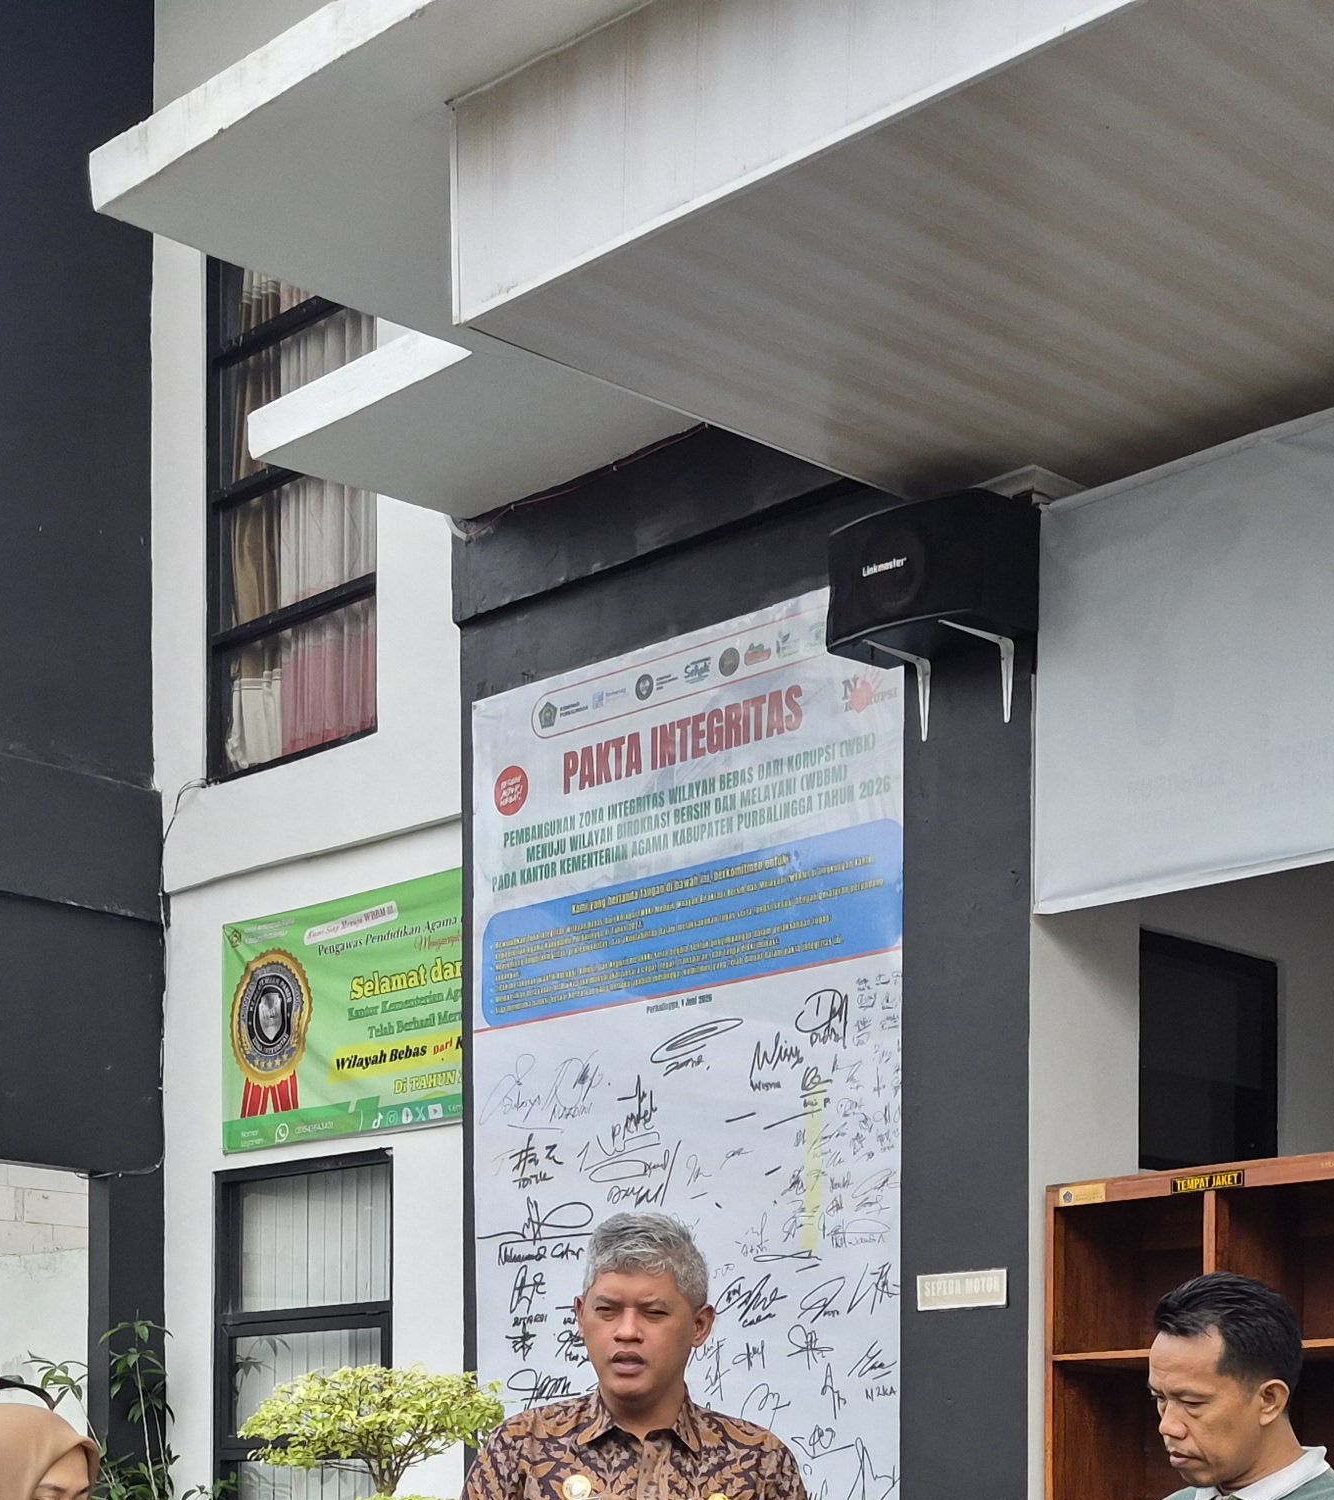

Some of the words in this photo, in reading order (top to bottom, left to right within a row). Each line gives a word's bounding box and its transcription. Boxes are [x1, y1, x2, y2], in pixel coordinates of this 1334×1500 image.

[563, 731, 642, 794] PAKTA
[650, 685, 803, 771] INTEGRITAS
[503, 815, 576, 848] PEMBANGUNAN
[579, 808, 605, 829] ZONA
[608, 790, 665, 821] INTEGRITAS
[668, 777, 716, 804] WILAYAH
[719, 769, 754, 792] BEBAS
[757, 759, 784, 781] DARI
[787, 743, 836, 772] KORUPSI
[839, 732, 876, 759] (WBK)
[492, 871, 518, 893] PADA
[520, 861, 557, 886] KANTOR
[559, 844, 628, 875] KEMENTERIAN
[631, 834, 669, 859] AGAMA
[672, 819, 734, 848] KABUPATEN
[737, 796, 814, 832] PURBALINGGA
[817, 784, 855, 811] TAHUN
[859, 775, 892, 800] 2026
[526, 841, 566, 864] MENUJU
[569, 827, 614, 853] WILAYAH
[616, 811, 671, 843] BIROKRASI
[673, 800, 711, 826] BERSIH
[716, 793, 737, 815] DAN
[740, 776, 797, 808] MELAYANI
[800, 764, 848, 793] (WBBM)
[640, 885, 665, 900] tangan
[713, 860, 764, 881] berkomitmen
[318, 937, 363, 956] Pengawas
[365, 924, 421, 945] Pendidikan
[422, 916, 457, 932] Agama
[350, 963, 427, 1001] Selamat
[335, 1049, 388, 1071] Wilayah
[388, 1044, 427, 1063] Bebas
[432, 1036, 453, 1055] Dari
[394, 1076, 407, 1094] Di
[410, 1068, 457, 1092] TAHUN
[1176, 1175, 1211, 1192] TEMPAT
[1212, 1173, 1239, 1188] JAKET
[924, 1278, 961, 1297] SEPEDA
[964, 1276, 1000, 1294] MOTOR
